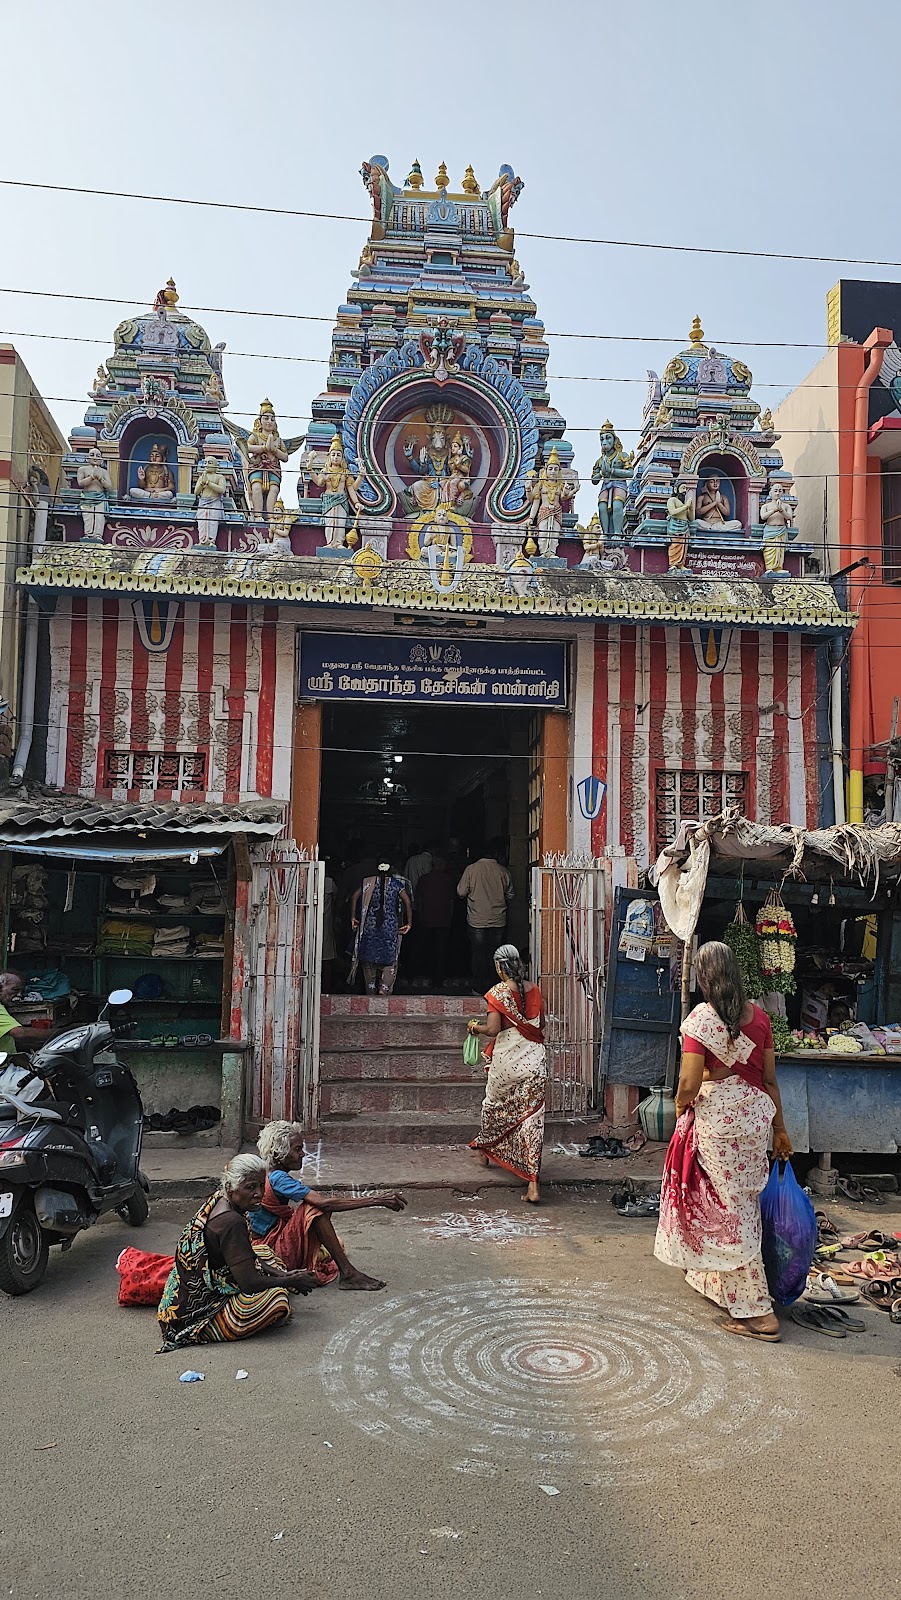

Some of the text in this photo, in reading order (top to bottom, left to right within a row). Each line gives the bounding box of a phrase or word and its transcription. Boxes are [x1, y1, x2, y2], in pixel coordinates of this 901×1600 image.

[321, 662, 349, 670] மதுரை
[364, 662, 399, 672] வேதாந்த
[401, 664, 423, 672] தேசிக
[338, 674, 416, 696] வேதாந்த
[420, 677, 487, 697] தேசிகன்
[491, 678, 560, 700] ஸன்னிதி
